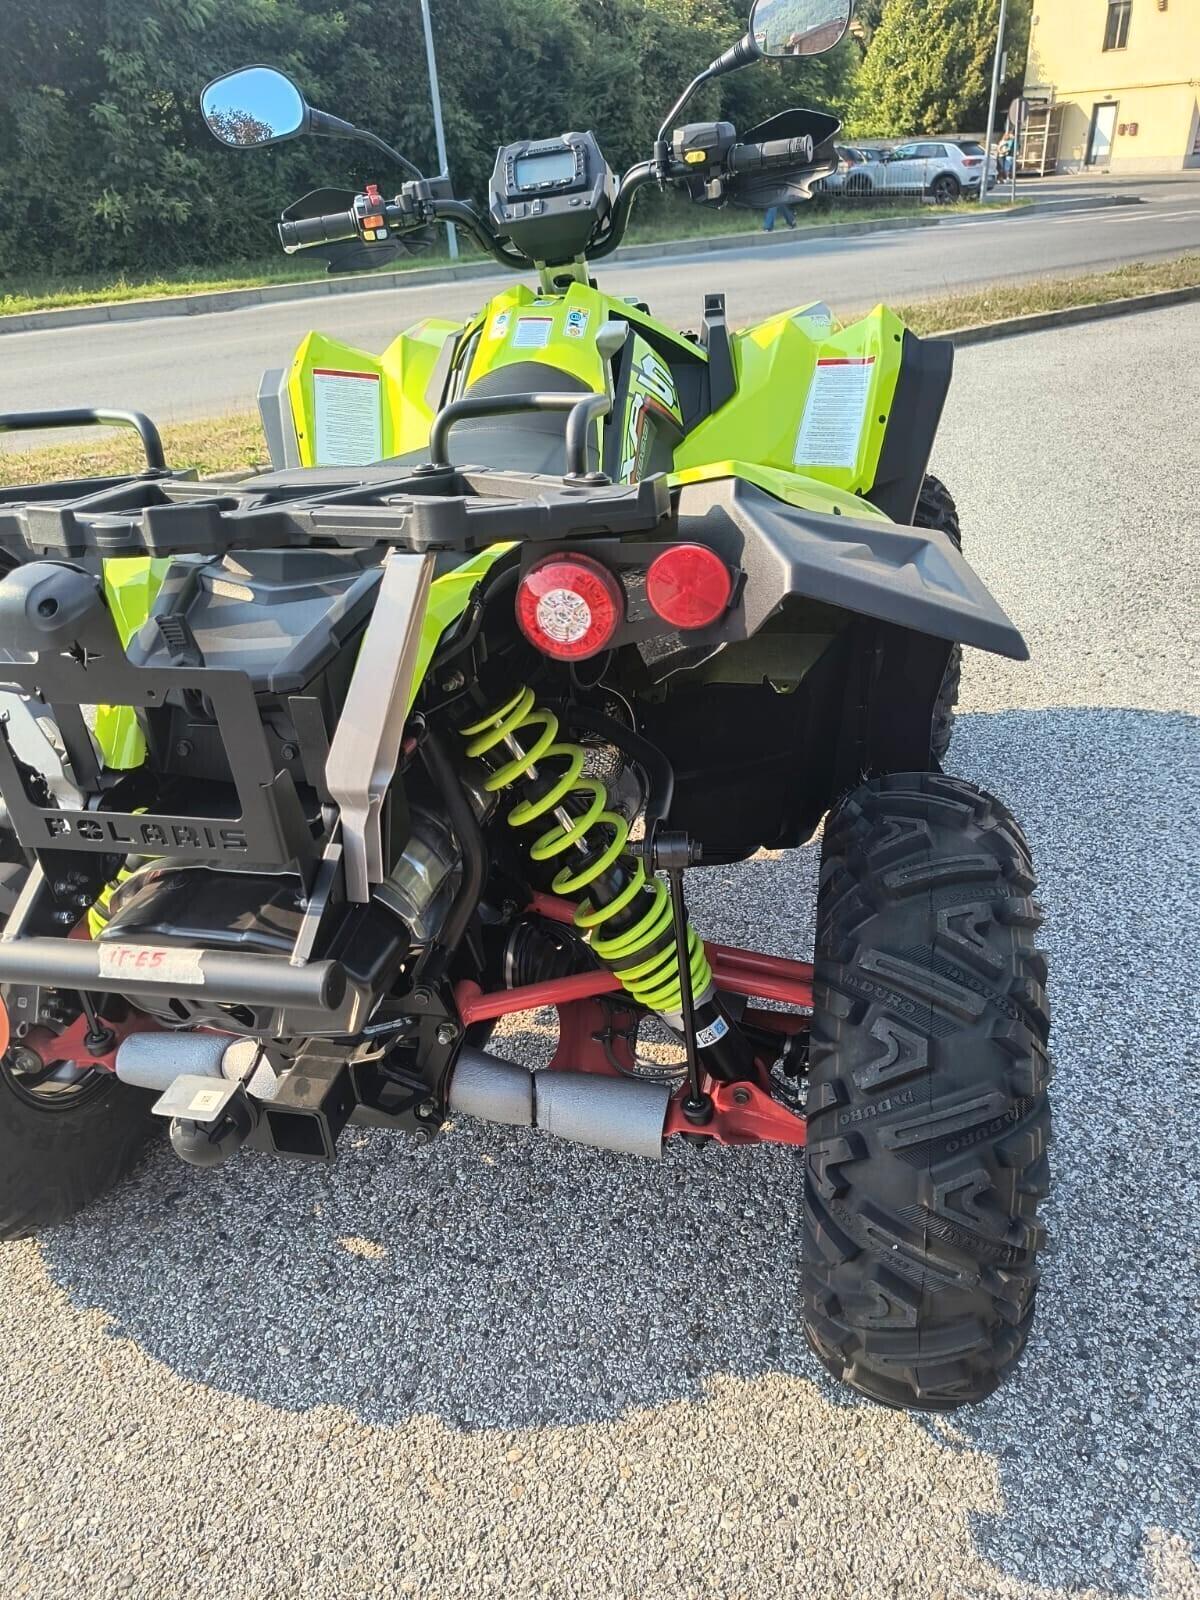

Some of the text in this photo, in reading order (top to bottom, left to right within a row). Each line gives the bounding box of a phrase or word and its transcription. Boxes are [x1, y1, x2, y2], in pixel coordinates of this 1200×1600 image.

[44, 817, 248, 851] POLARIS
[860, 980, 916, 1014] DURO
[839, 1099, 892, 1125] DURO
